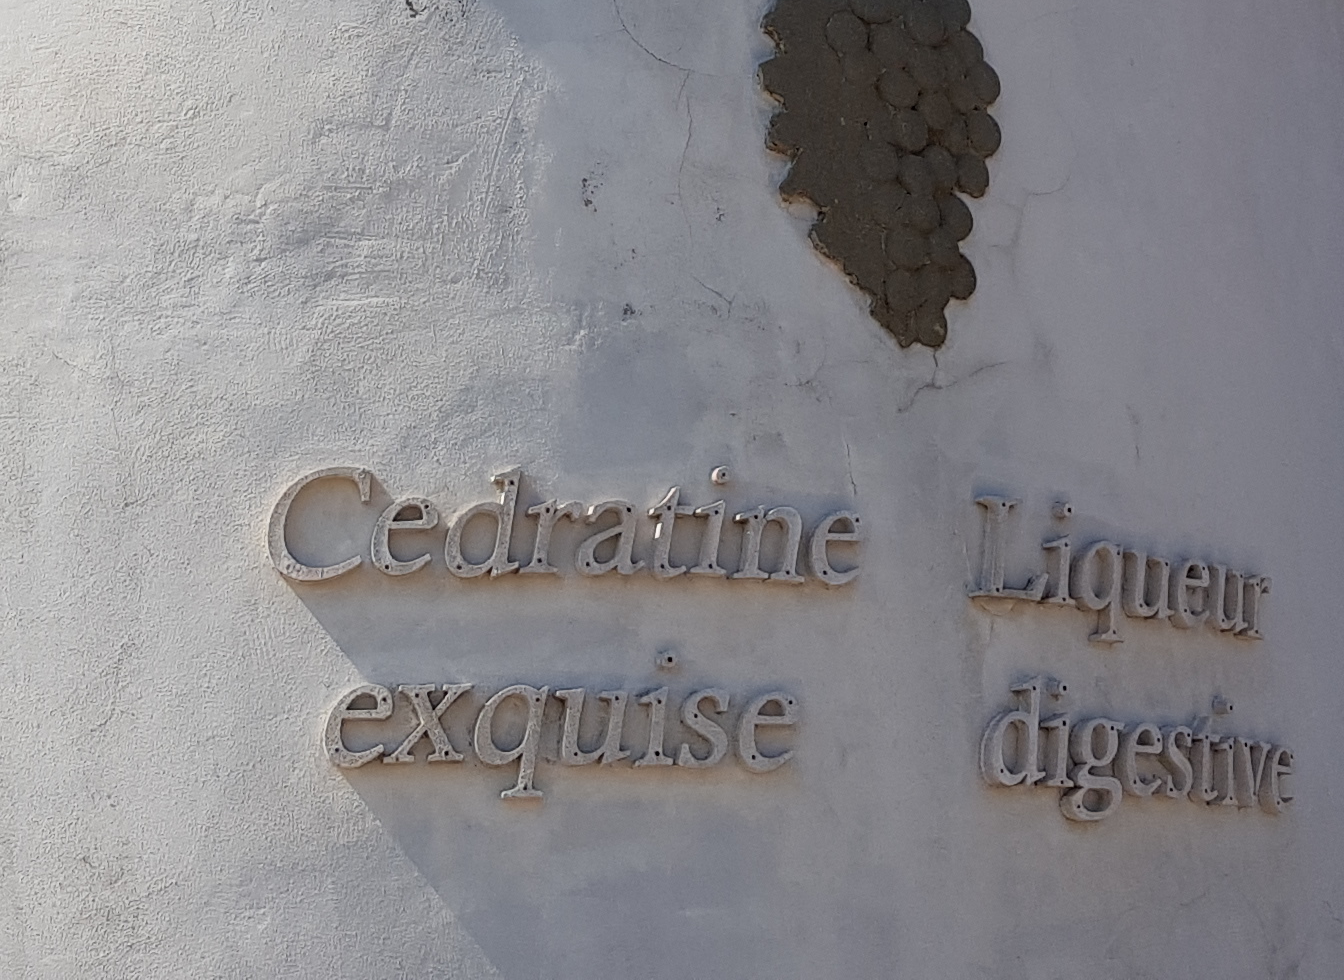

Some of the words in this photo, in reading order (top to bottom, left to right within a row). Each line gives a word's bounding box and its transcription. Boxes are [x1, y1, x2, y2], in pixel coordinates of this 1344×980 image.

[265, 464, 862, 586] Cedratine
[967, 494, 1272, 644] Liqueur
[322, 649, 801, 799] exquise
[979, 675, 1297, 821] digestive
